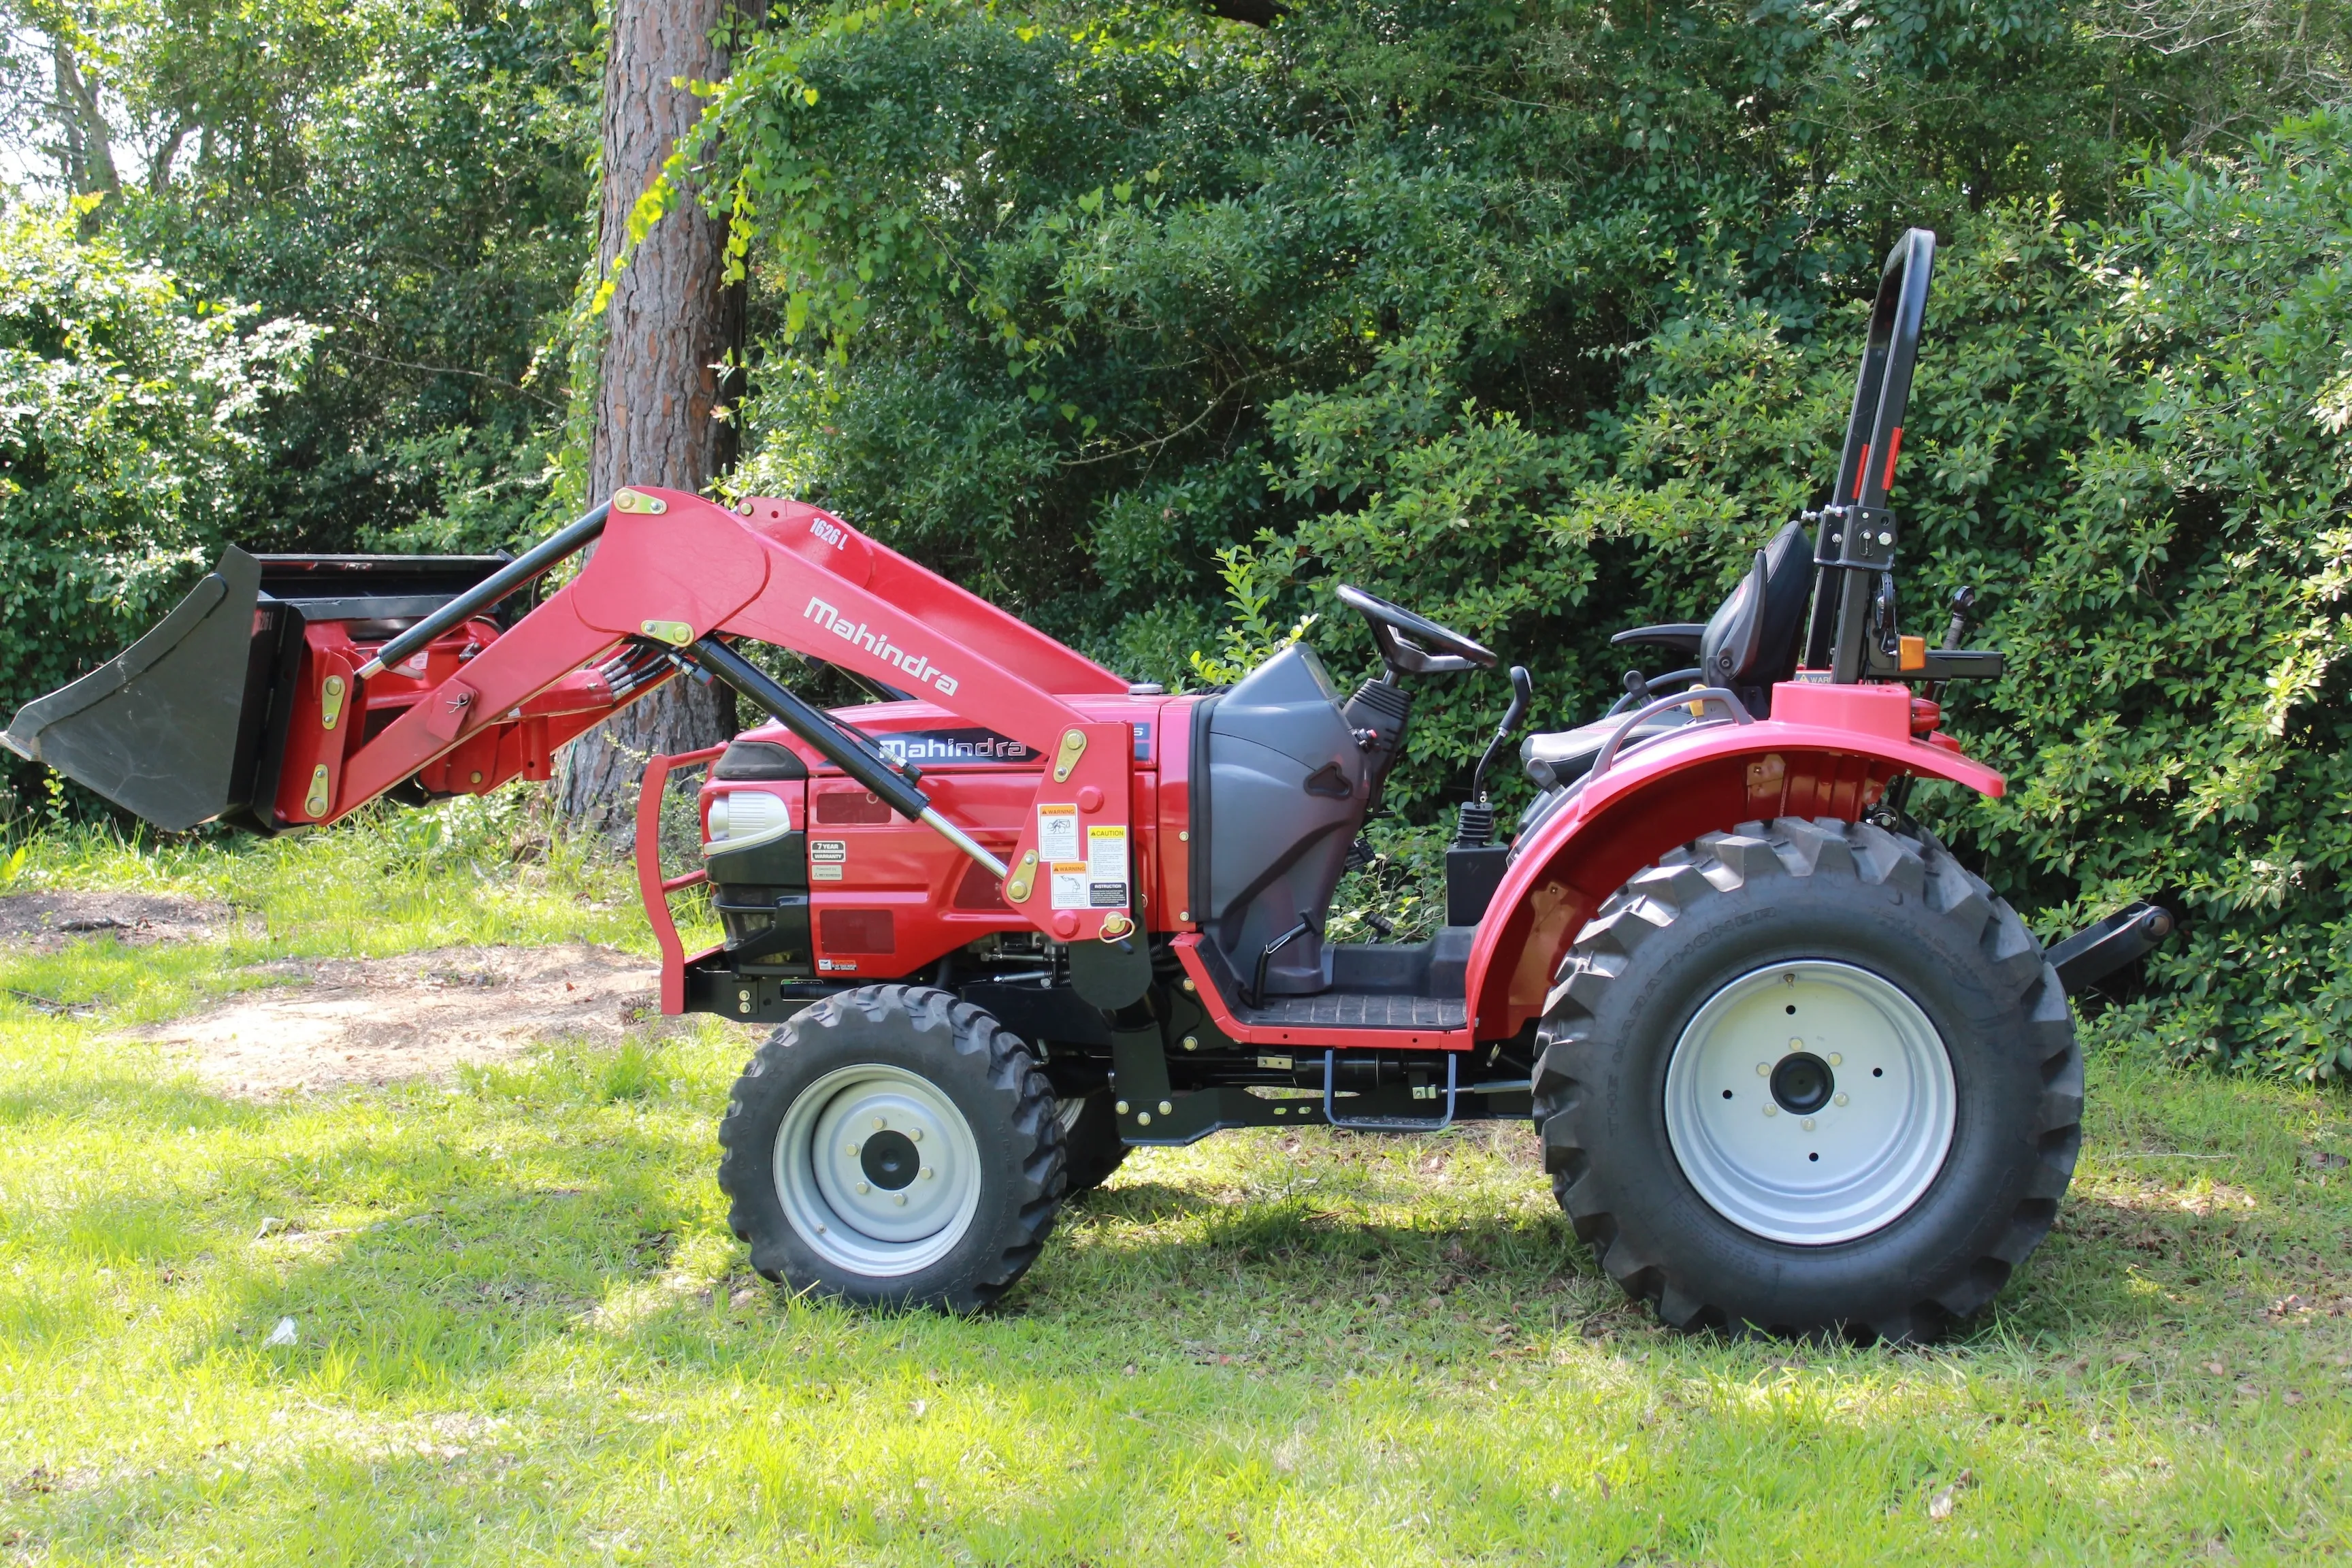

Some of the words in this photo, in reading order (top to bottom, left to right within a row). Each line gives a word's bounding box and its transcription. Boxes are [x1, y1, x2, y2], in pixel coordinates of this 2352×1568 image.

[809, 517, 841, 545] 1626
[836, 533, 849, 551] L
[803, 596, 959, 697] Mahindra
[879, 738, 1026, 758] Mahindra
